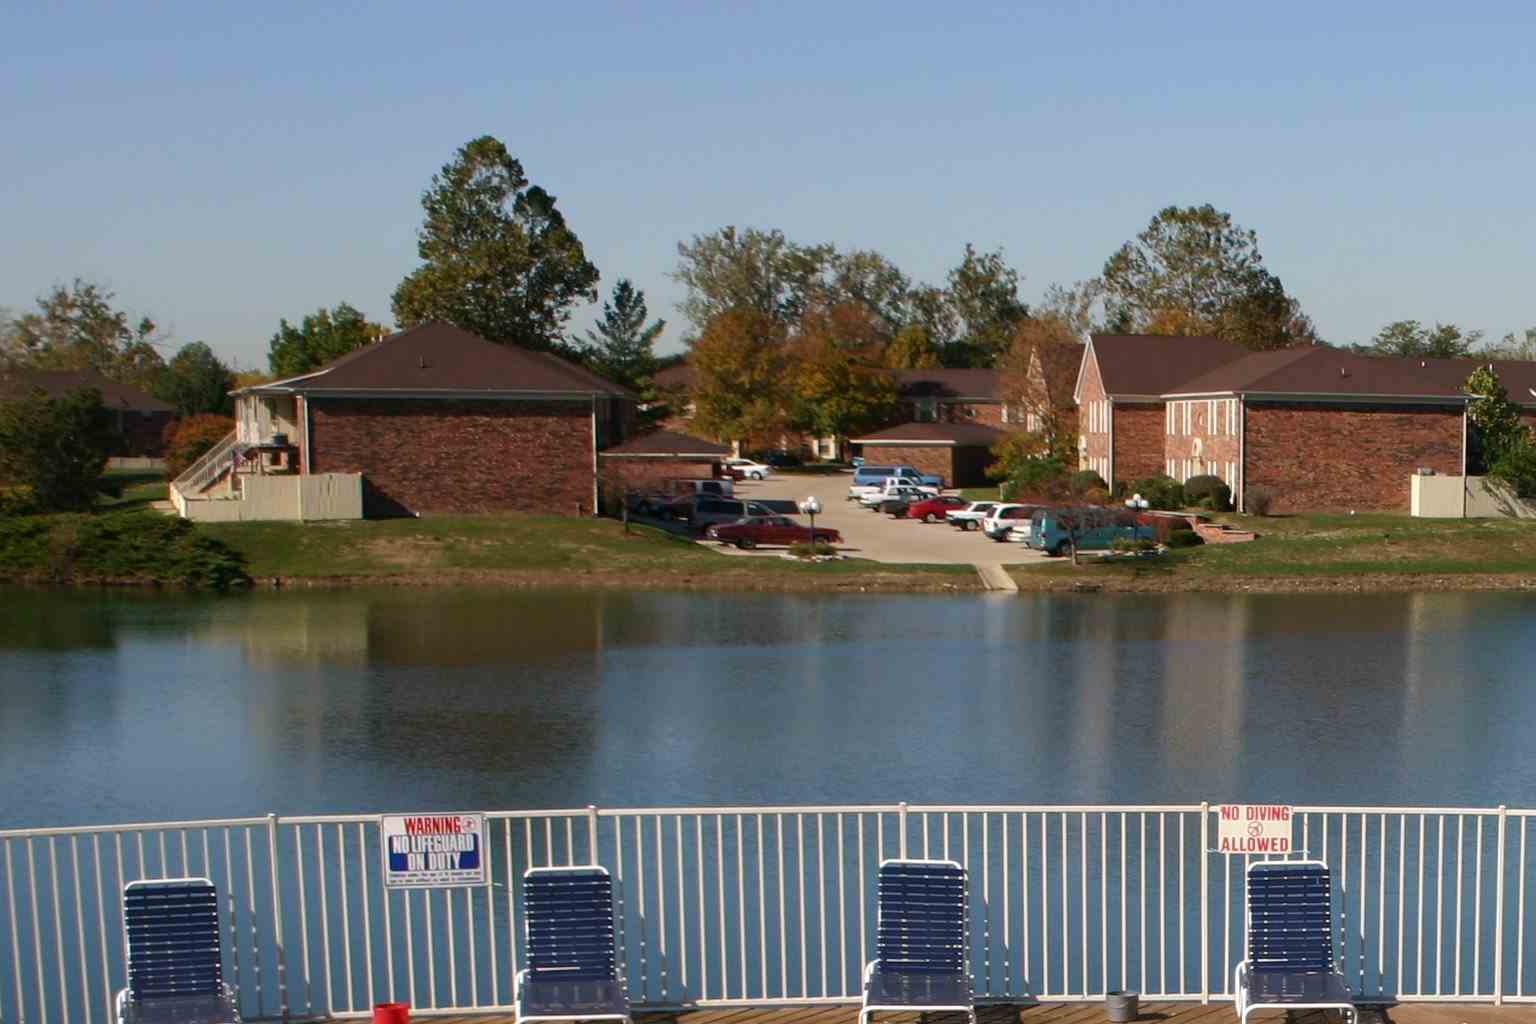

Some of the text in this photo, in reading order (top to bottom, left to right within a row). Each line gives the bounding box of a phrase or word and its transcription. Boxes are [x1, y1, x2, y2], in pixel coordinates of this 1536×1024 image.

[1220, 806, 1290, 821] NO DIVING
[404, 816, 461, 834] WARNING
[392, 833, 475, 854] NO LIFEGUARD
[1221, 836, 1289, 852] ALLOWED
[407, 851, 460, 871] ON DUTY
